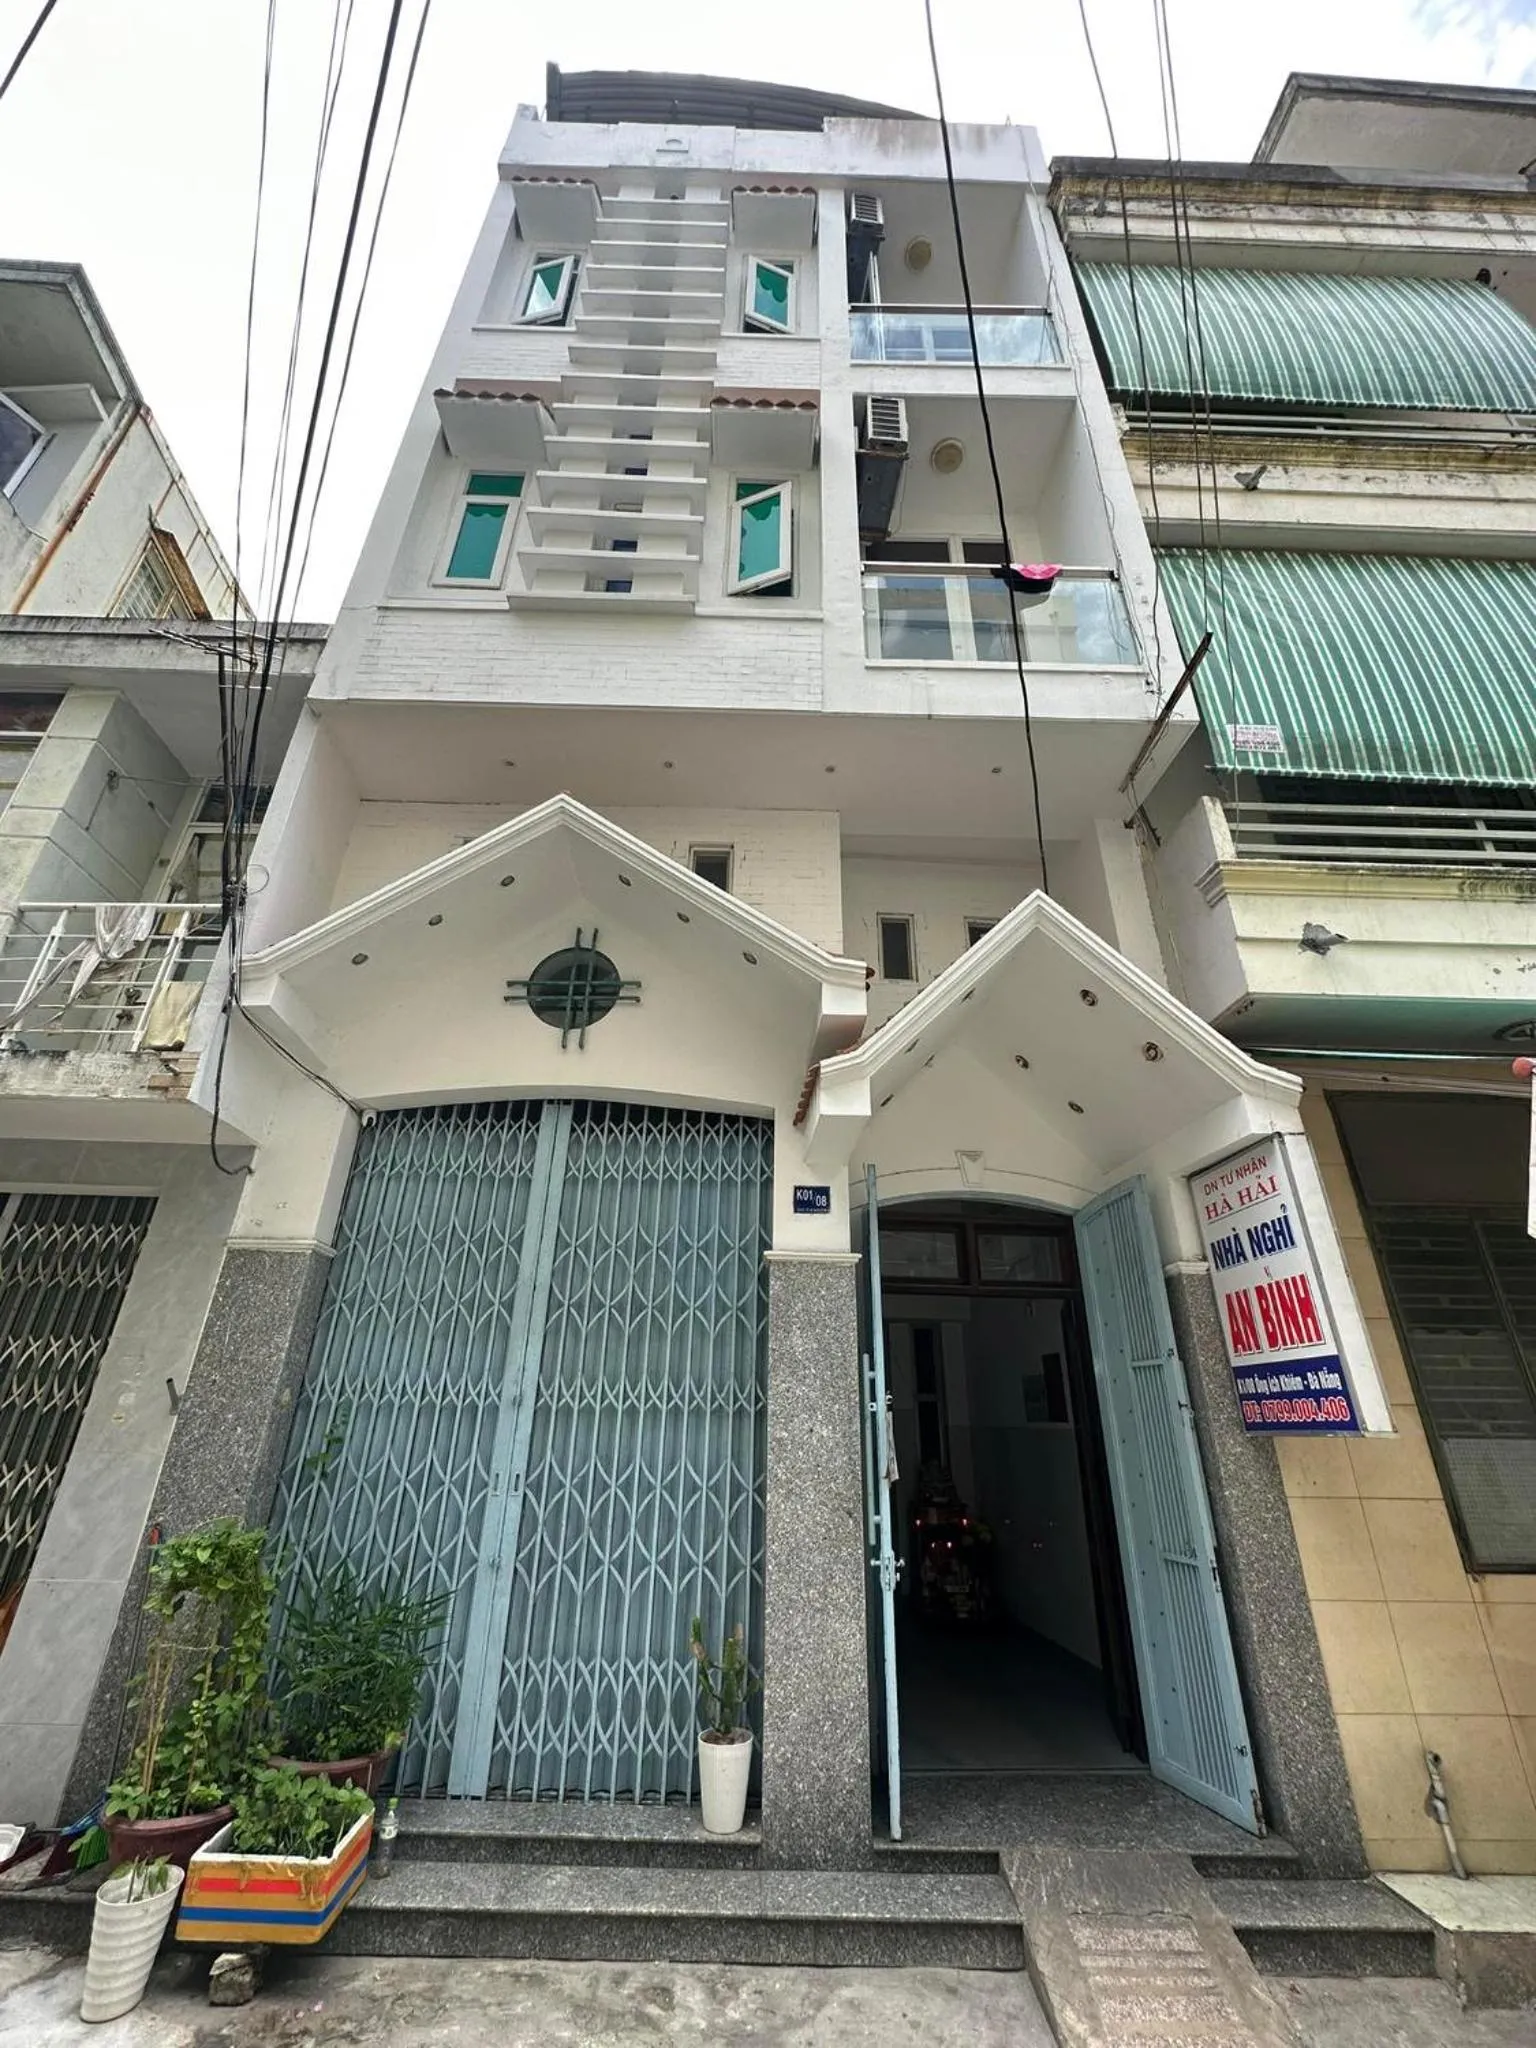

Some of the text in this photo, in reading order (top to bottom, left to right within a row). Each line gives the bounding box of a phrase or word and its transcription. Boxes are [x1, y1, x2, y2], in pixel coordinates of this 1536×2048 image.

[1235, 1155, 1267, 1180] NHÂN
[1204, 1174, 1279, 1220] HÀ HẢI
[1210, 1203, 1296, 1270] NHÀ NGHỈ
[1225, 1287, 1262, 1354] AN
